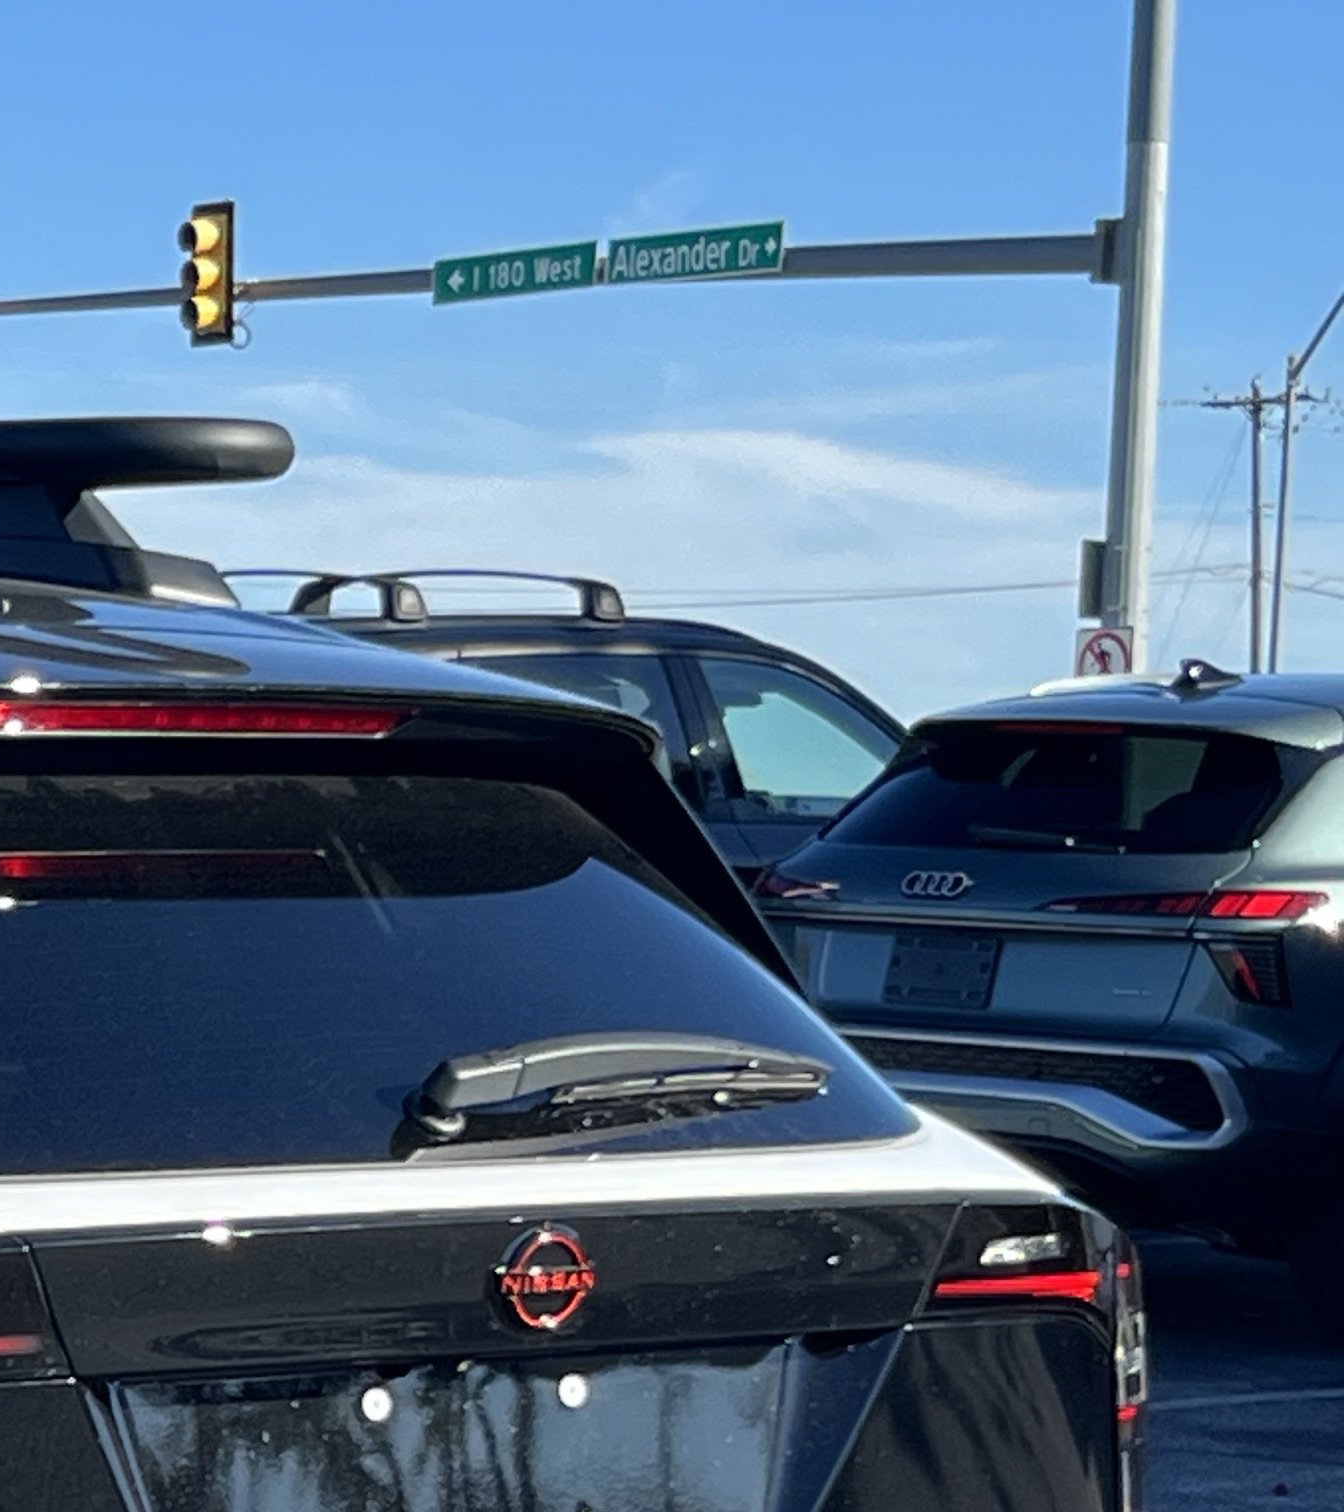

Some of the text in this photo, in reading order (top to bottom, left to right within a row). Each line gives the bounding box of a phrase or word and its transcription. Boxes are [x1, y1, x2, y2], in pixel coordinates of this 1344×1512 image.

[488, 260, 525, 290] 180
[534, 255, 583, 284] West
[612, 235, 759, 280] Alexander Dr
